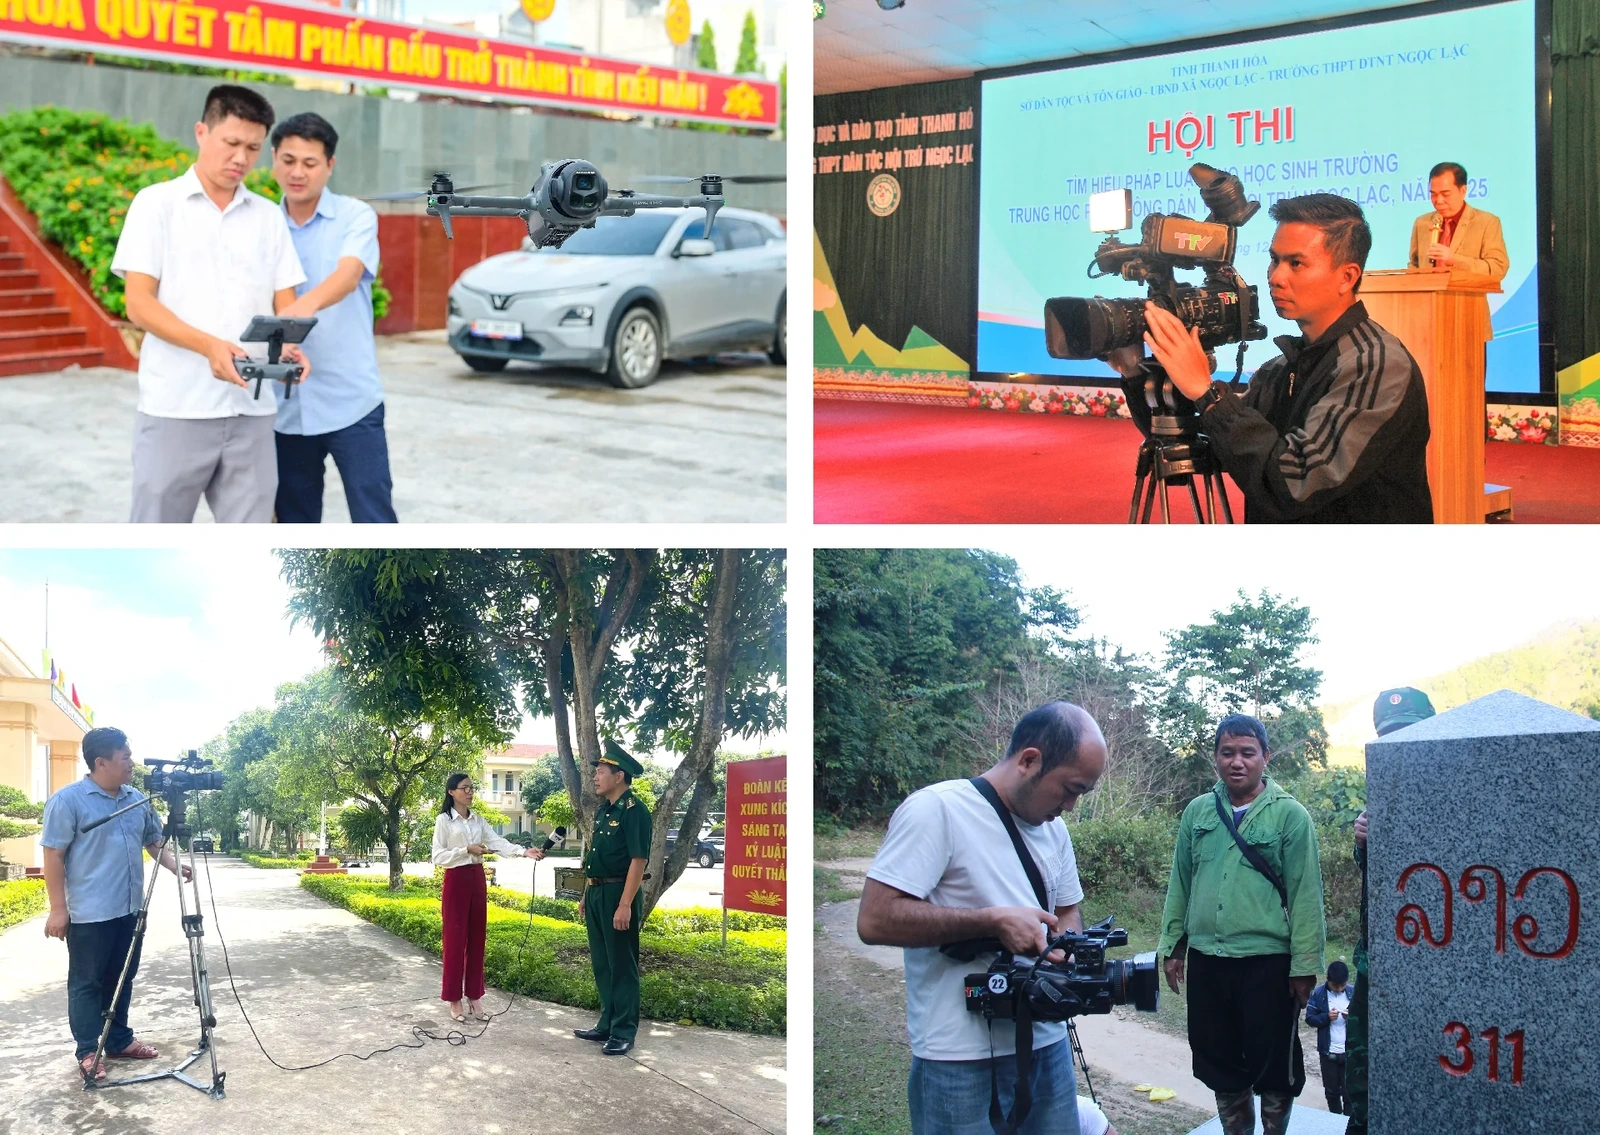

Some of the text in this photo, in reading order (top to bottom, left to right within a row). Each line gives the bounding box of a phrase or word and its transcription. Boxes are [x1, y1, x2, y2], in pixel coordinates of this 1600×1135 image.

[224, 5, 297, 60] TÂM
[300, 18, 384, 71] PHẤN
[387, 29, 442, 78] ĐẤU
[443, 39, 492, 85] TRỞ
[494, 51, 568, 95] THÀNH
[1199, 58, 1240, 74] THANH
[1243, 53, 1268, 68] HÓA
[1034, 97, 1053, 110] DÂN
[1055, 95, 1077, 108] TỘC
[1093, 89, 1114, 103] TÔN
[1115, 86, 1143, 100] GIÁO
[1150, 83, 1179, 96] UBND
[1181, 78, 1197, 92] XÃ
[1200, 77, 1232, 90] NGỌC
[1267, 64, 1319, 81] TRƯỜNG
[1322, 59, 1356, 74] THPT
[1359, 54, 1394, 69] DTNT
[1397, 48, 1437, 65] NGỌC
[816, 124, 836, 147] DỤC
[837, 120, 850, 142] VÀ
[874, 119, 893, 141] TẠO
[895, 112, 919, 137] TỈNH
[921, 112, 956, 134] THANH
[1147, 105, 1294, 159] HỘI THI
[818, 155, 841, 174] THPT
[842, 150, 863, 173] DÂN
[864, 148, 883, 173] TỘC
[884, 146, 902, 172] NỘI
[903, 144, 923, 168] TRÚ
[925, 145, 953, 168] NGỌC
[1066, 174, 1087, 195] TÌM
[1125, 168, 1161, 190] PHÁP
[1243, 162, 1276, 186] HỌC
[1281, 160, 1318, 180] SINH
[1323, 150, 1399, 177] TRƯỜNG
[1008, 205, 1050, 224] TRUNG
[1054, 203, 1080, 225] HỌC
[1133, 196, 1162, 217] ÔNG
[1166, 193, 1197, 214] DÂN
[1401, 177, 1431, 203] NĂ
[1467, 178, 1489, 199] 25
[1174, 232, 1213, 251] TTV
[1217, 291, 1239, 305] TT
[743, 779, 771, 795] ĐOÀN
[740, 803, 767, 815] XUNG
[742, 821, 787, 840] SÁNG TẠ
[745, 841, 787, 861] KỶ LUẬT
[732, 862, 787, 881] QUYẾT THẮ
[1396, 862, 1580, 959] ລາວ
[991, 978, 1005, 990] 22
[1438, 1021, 1525, 1087] 311
